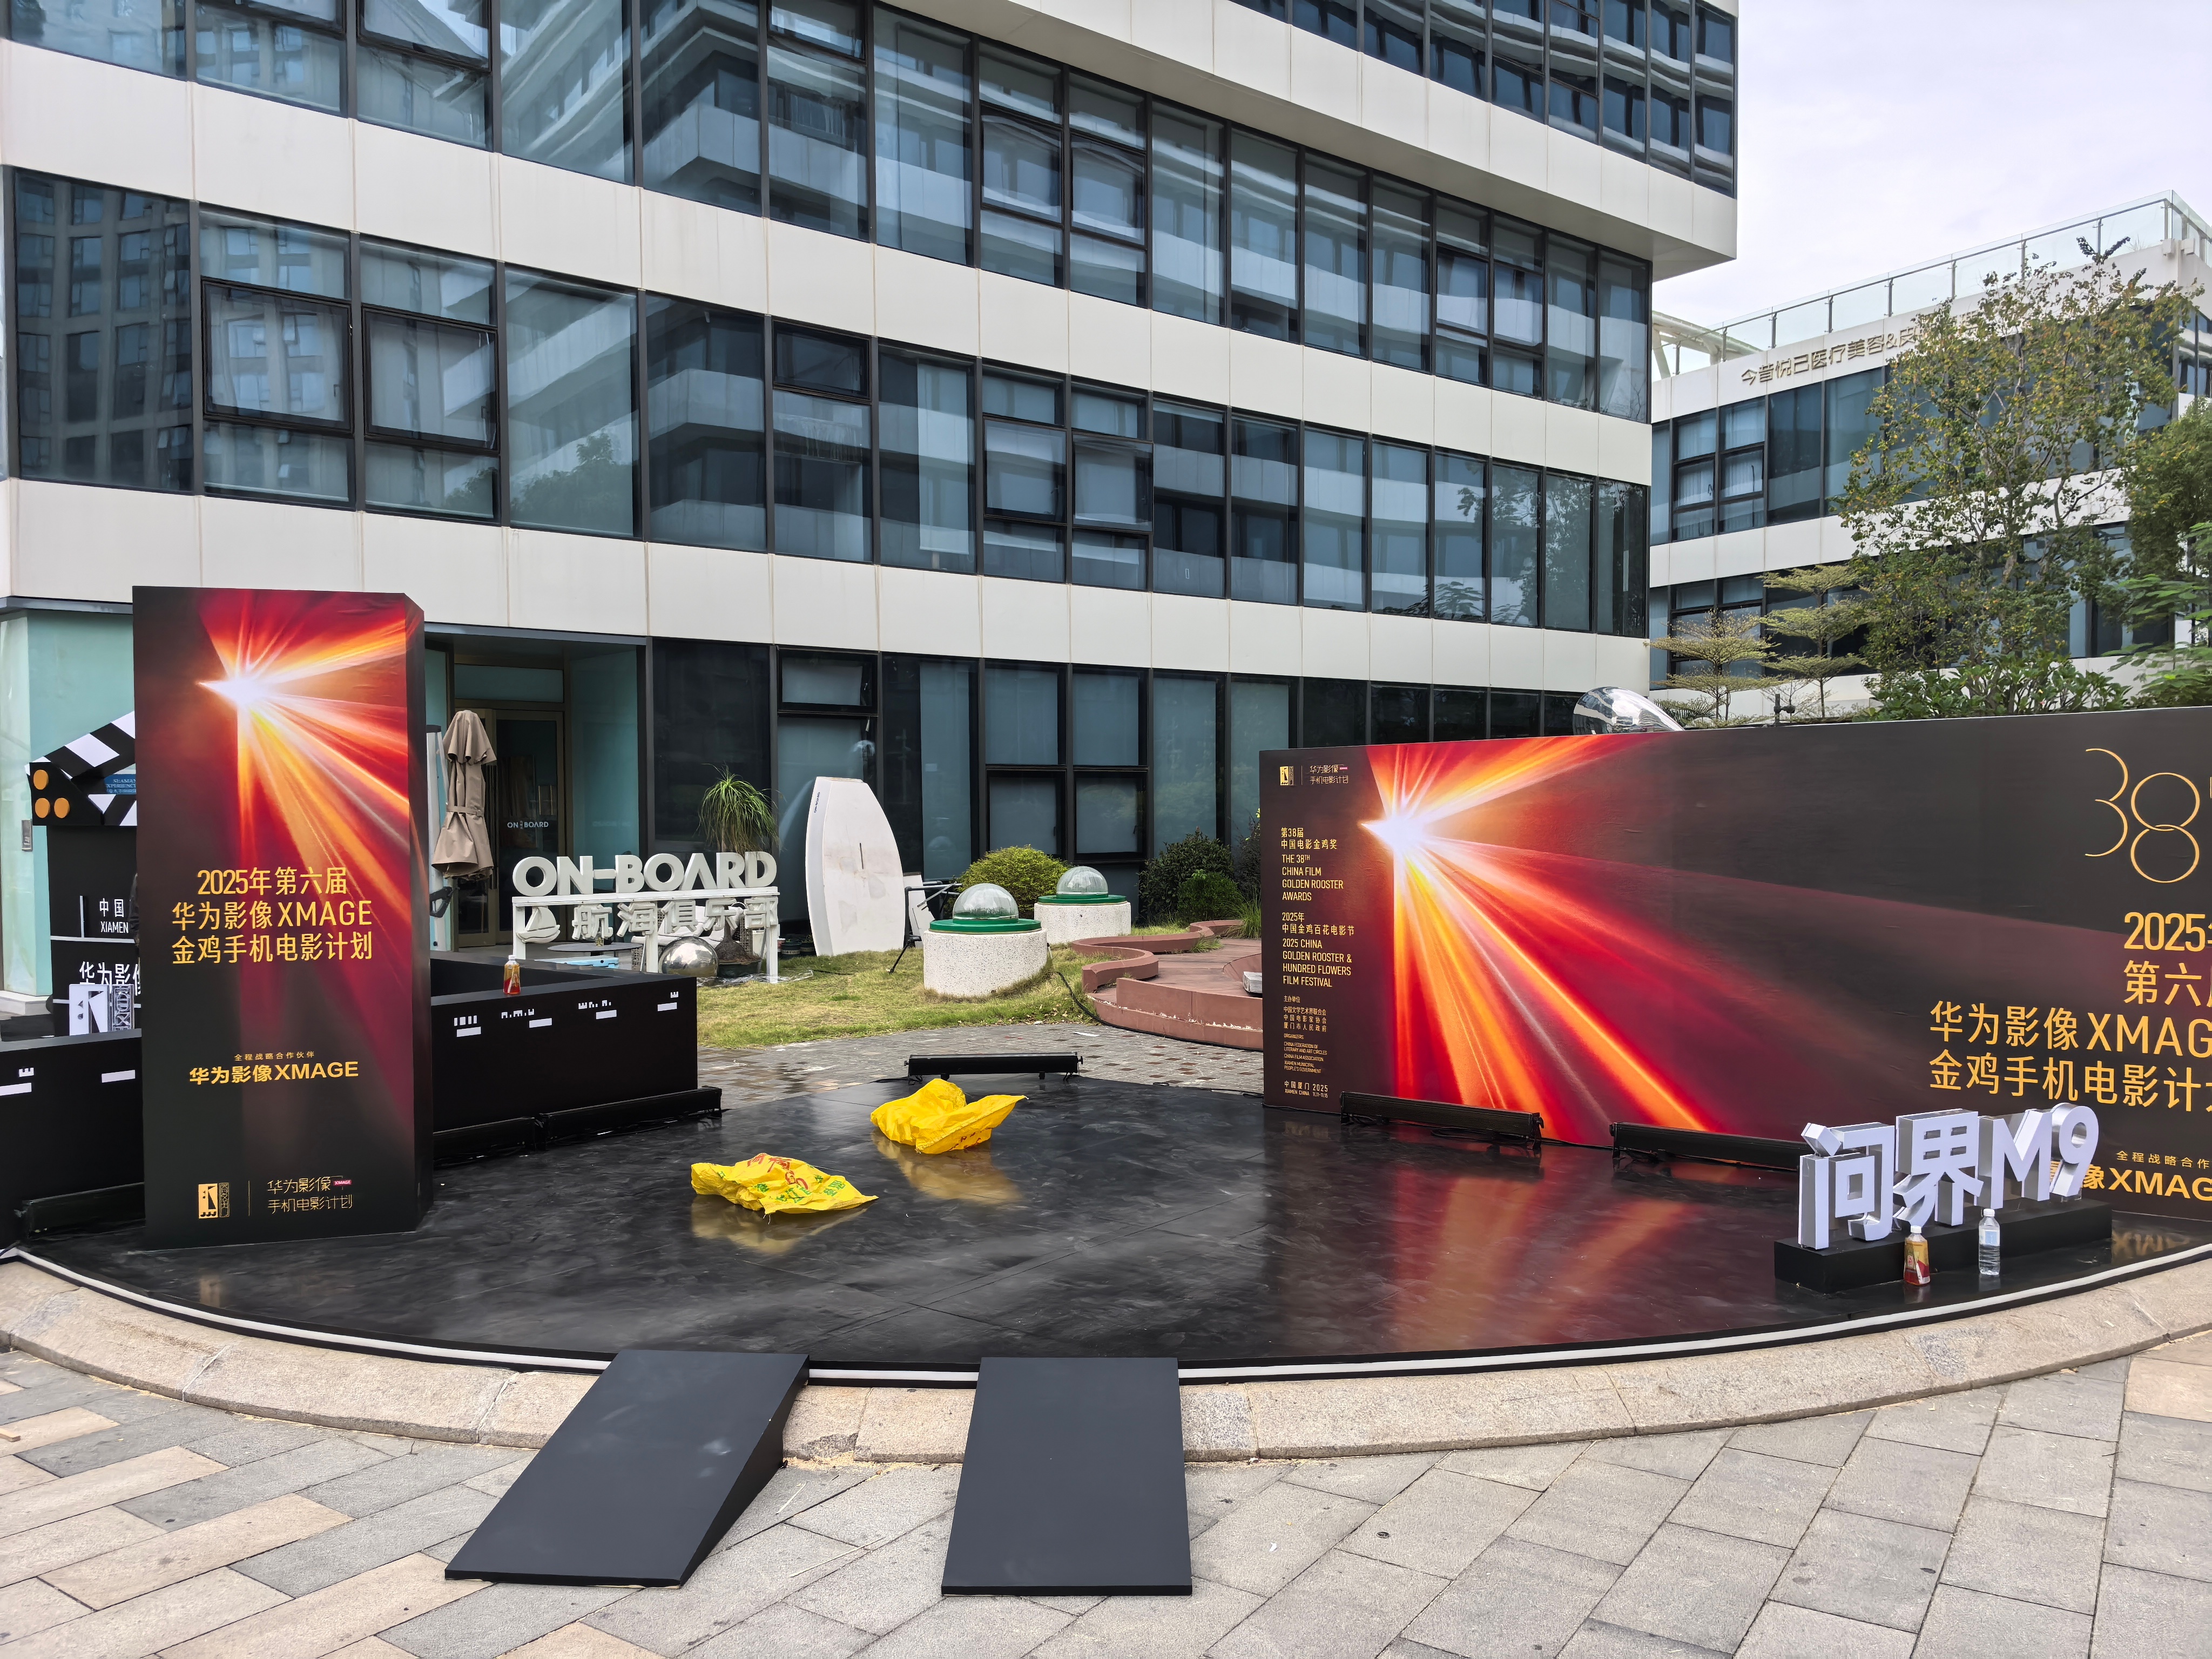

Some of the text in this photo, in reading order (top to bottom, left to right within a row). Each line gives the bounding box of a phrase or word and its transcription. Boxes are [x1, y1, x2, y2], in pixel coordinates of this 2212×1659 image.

[1310, 765, 1339, 774] 华为影像
[1310, 775, 1348, 785] 手机电影计划
[2085, 748, 2212, 883] 38
[1281, 827, 1304, 838] 第38届
[1281, 839, 1337, 849] 中国电影金鸡奖
[1282, 854, 1310, 864] THE 38TH
[512, 851, 777, 897] ON-BOARD
[1282, 867, 1321, 876] CHINA FILM
[198, 867, 347, 896] 2025年第六届
[1282, 879, 1343, 889] GOLDEN ROOSTER
[1282, 892, 1312, 901] AWARDS
[99, 898, 124, 918] 中国
[572, 895, 778, 941] 航海俱乐部
[1282, 912, 1305, 922] 2025年
[100, 921, 129, 933] XIAMEN
[1282, 923, 1354, 936] 中国金鸡百花电影节
[2124, 912, 2212, 952] 2025
[171, 932, 373, 965] 金鸡手机电影计划
[1283, 938, 1323, 949] 2025 CHINA
[1283, 950, 1352, 963] GOLDEN ROOSTER &
[1283, 963, 1351, 976] HUNDRED FLOWERS
[1283, 976, 1332, 987] FILM FESTIVAL
[2124, 960, 2212, 1008] 第六
[1284, 1014, 1327, 1024] 中国电影家协会
[1284, 1022, 1327, 1032] 厦门市人民政府
[234, 1051, 314, 1061] 全程战略合作伙伴
[190, 1061, 359, 1085] 华为影像XMAGE
[1284, 1080, 1328, 1092] 中国厦门 2025
[2115, 1150, 2210, 1170] 全程战略合作
[267, 1177, 331, 1195] 华为影像
[2051, 1160, 2212, 1202] 像XMAG
[267, 1194, 353, 1215] 手机电影计划
